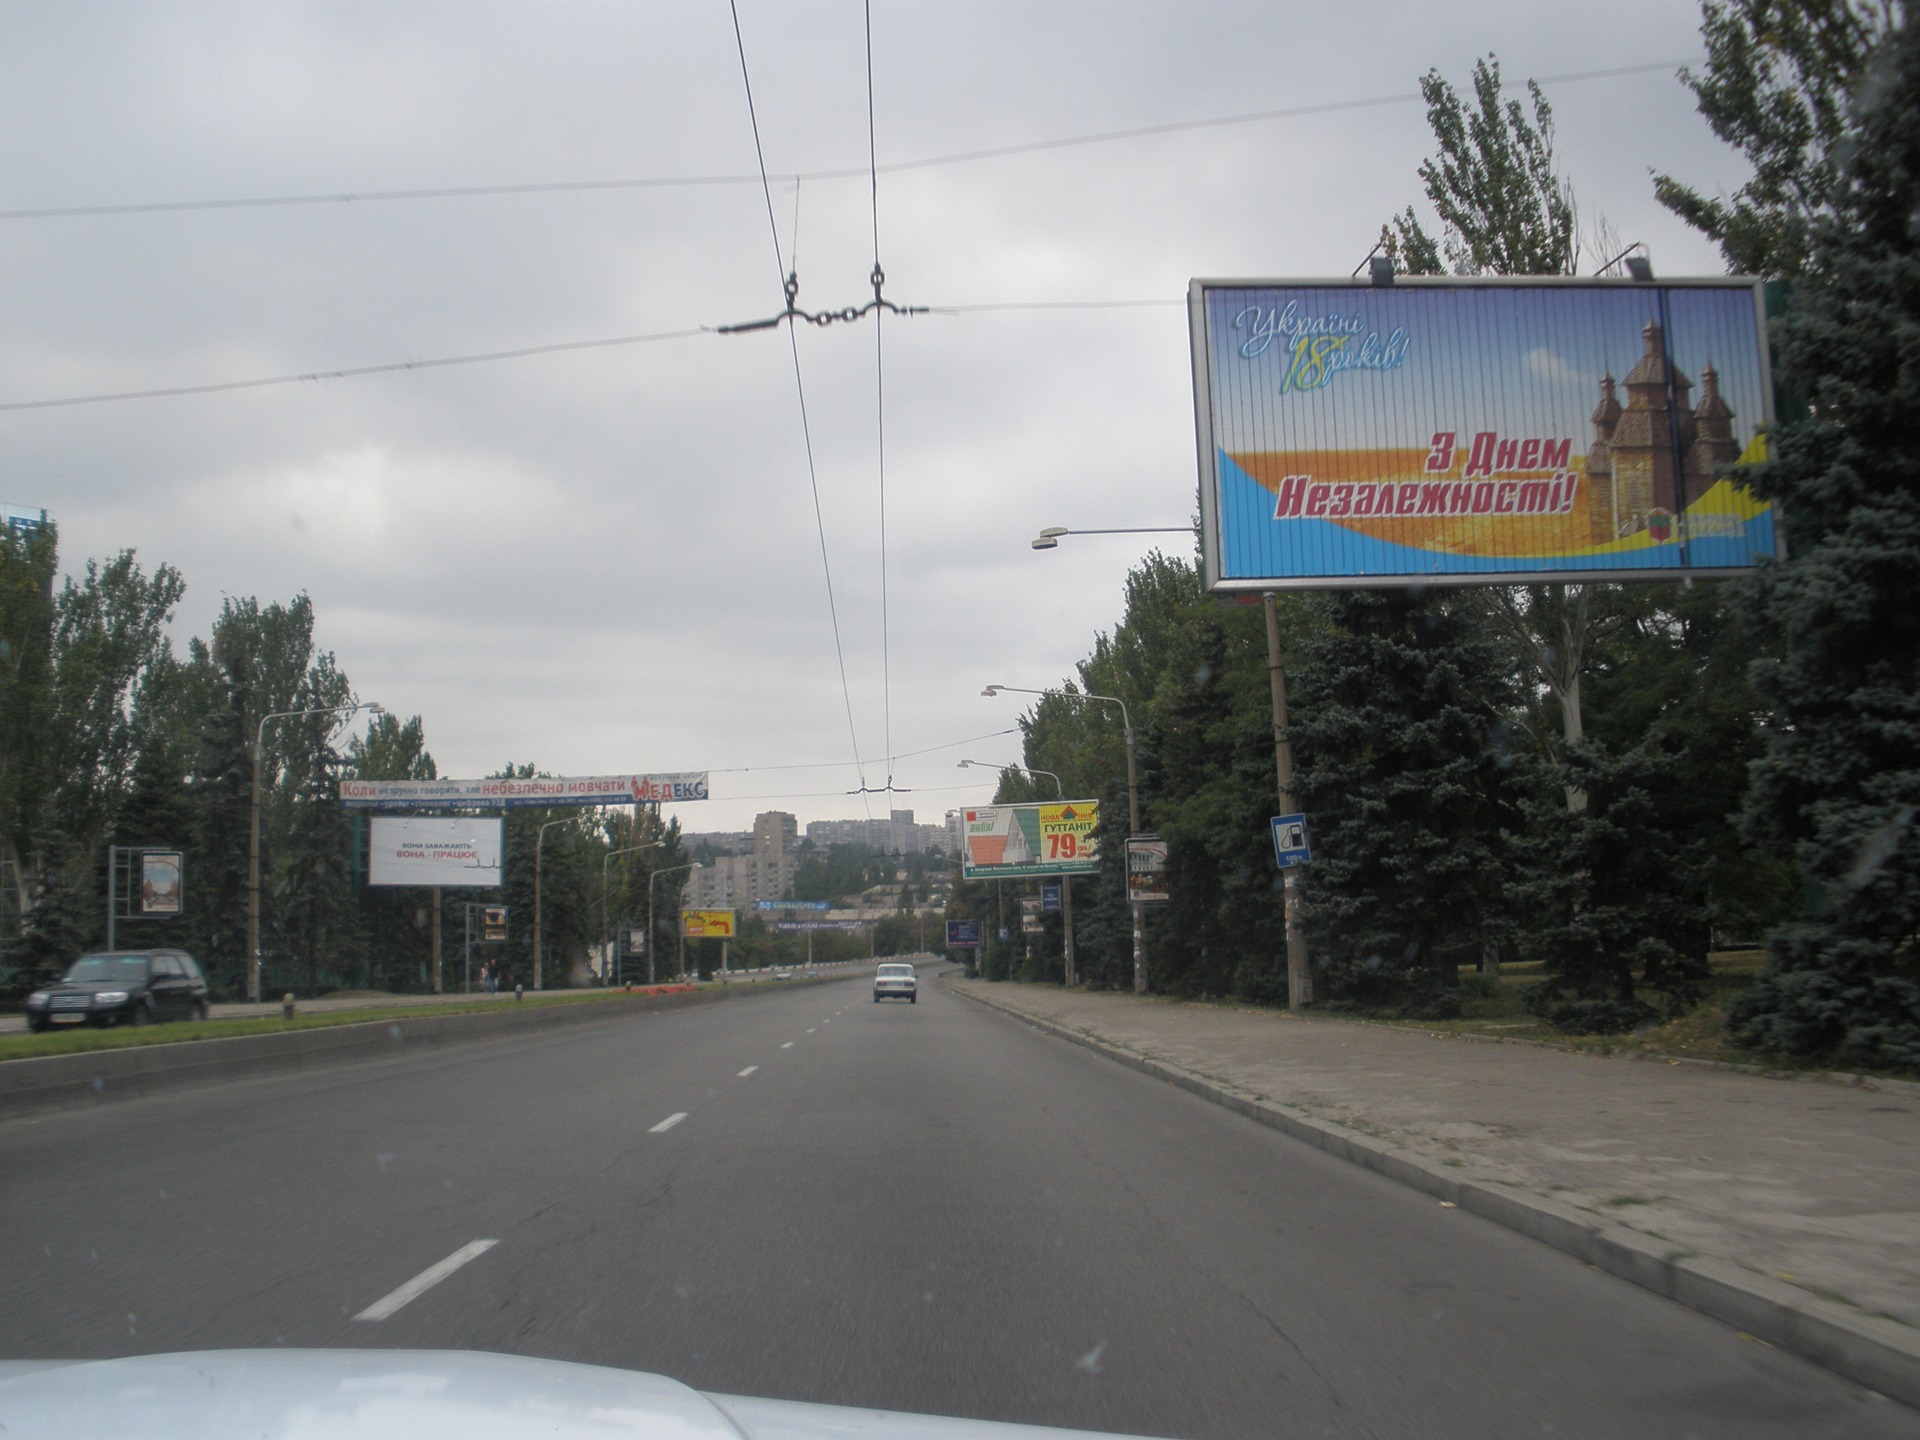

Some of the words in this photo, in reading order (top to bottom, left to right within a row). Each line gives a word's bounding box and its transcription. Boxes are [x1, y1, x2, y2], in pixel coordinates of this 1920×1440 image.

[1235, 299, 1365, 357] Україні
[1281, 334, 1350, 394] 18
[1424, 431, 1456, 473] З
[1463, 431, 1572, 478] Днем
[1273, 472, 1579, 520] Незалежності!
[344, 782, 376, 796] Коли
[483, 779, 564, 795] небезпечно
[568, 780, 626, 793] мовчати
[1044, 822, 1093, 833] ГУТТАНІТ
[396, 850, 425, 858] ВОНА
[432, 850, 478, 859] ПРАЦЮЄ
[1046, 833, 1076, 859] 79
